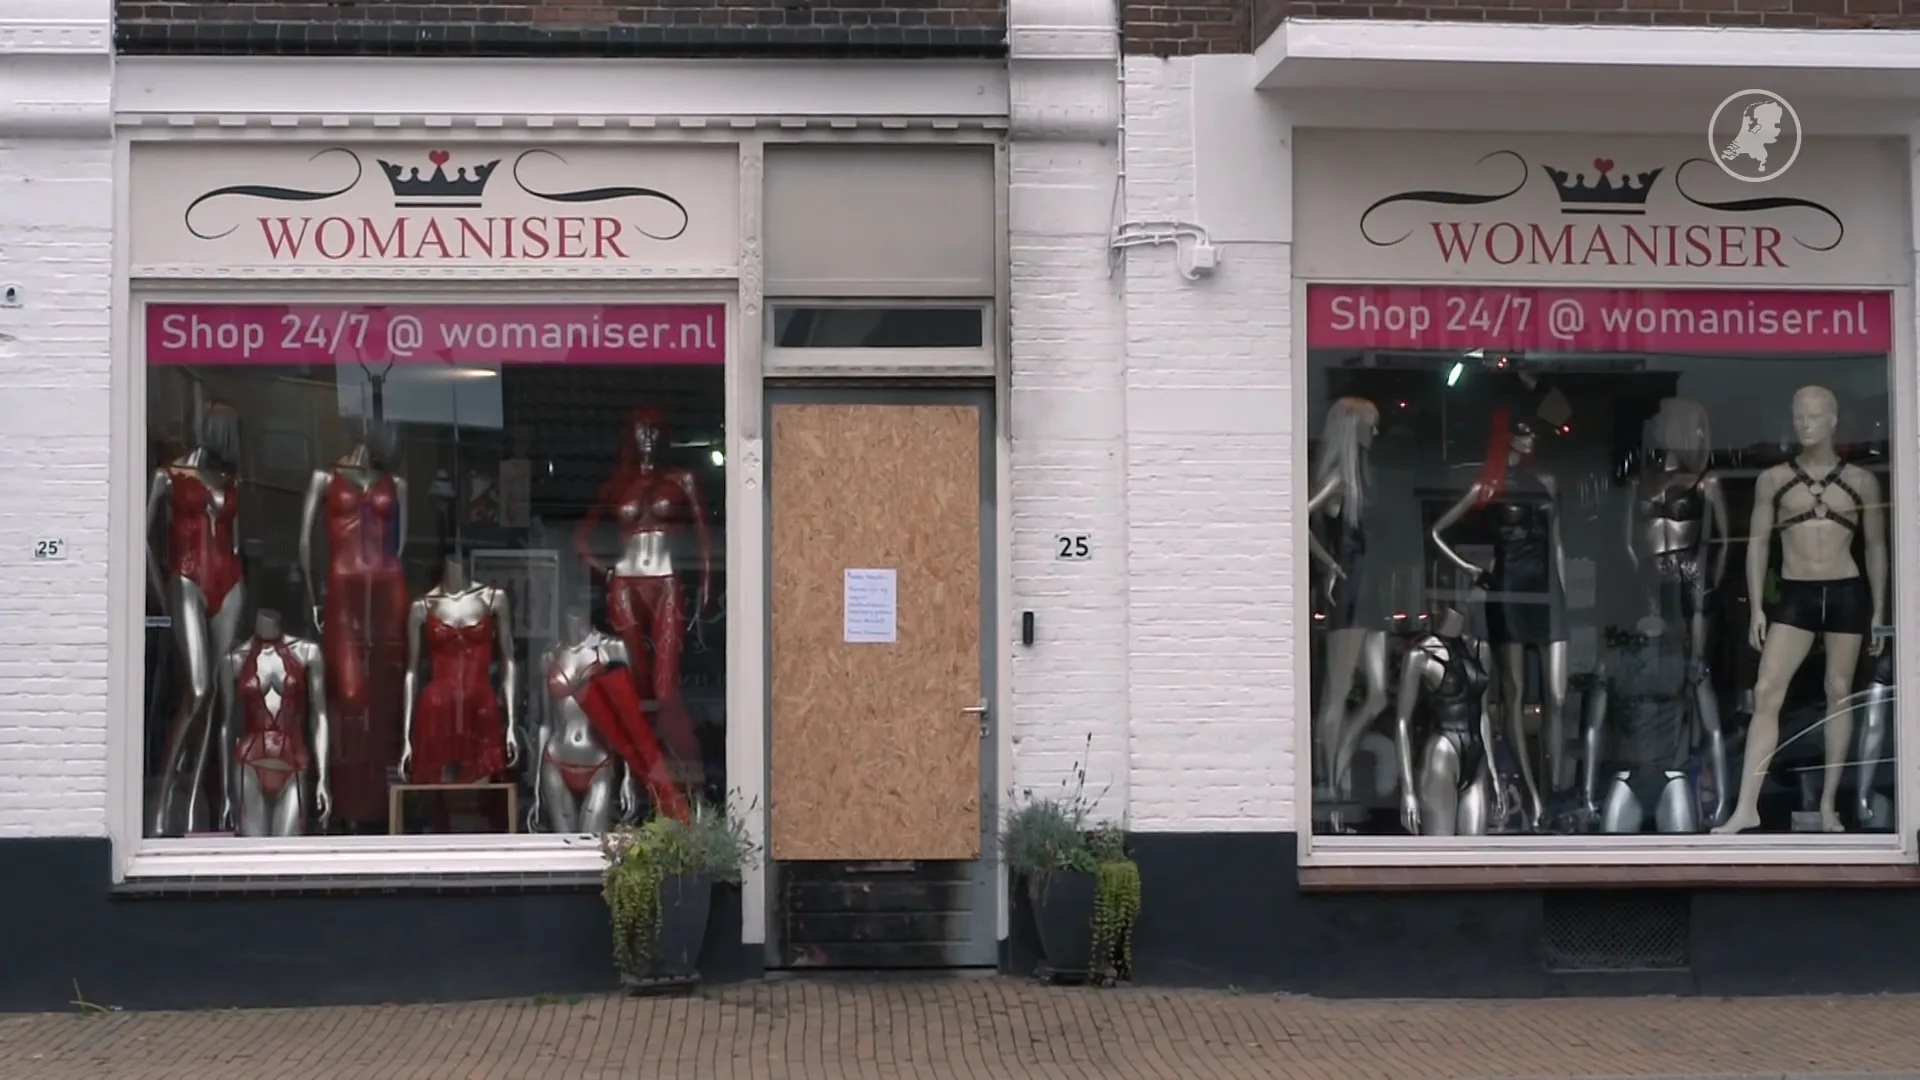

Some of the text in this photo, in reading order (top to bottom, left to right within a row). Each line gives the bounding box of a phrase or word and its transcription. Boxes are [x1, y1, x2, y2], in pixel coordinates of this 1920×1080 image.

[257, 216, 630, 259] WOMANISER
[1430, 221, 1790, 268] WOMANISER
[162, 311, 716, 357] Shop 24/7 @ womaniser.nl
[1331, 293, 1868, 340] Shop 24/7 @ womaniser.nl
[1059, 536, 1089, 557] 25
